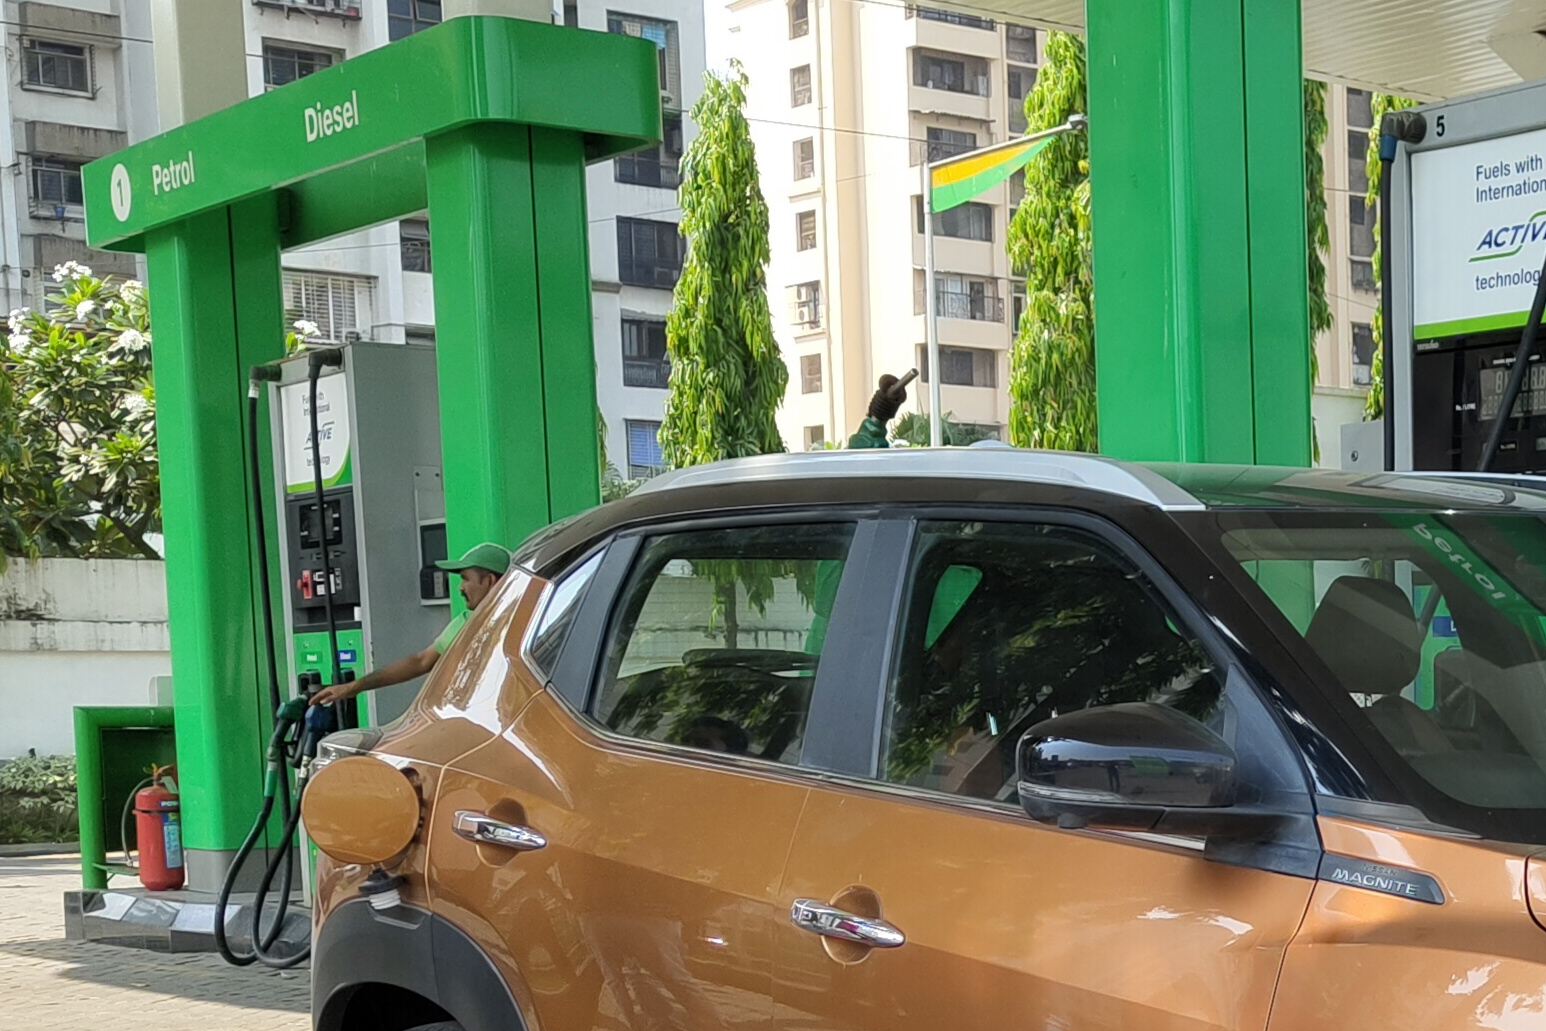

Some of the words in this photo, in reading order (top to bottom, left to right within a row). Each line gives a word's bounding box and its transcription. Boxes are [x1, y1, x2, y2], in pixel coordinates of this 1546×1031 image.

[304, 90, 359, 142] Diesel
[1436, 115, 1446, 137] 5
[116, 178, 124, 207] 1
[152, 151, 195, 195] Petrol
[1476, 161, 1511, 181] Fuels
[1515, 154, 1543, 174] with
[1476, 268, 1541, 291] technolog
[1332, 867, 1420, 896] MAGNITE
